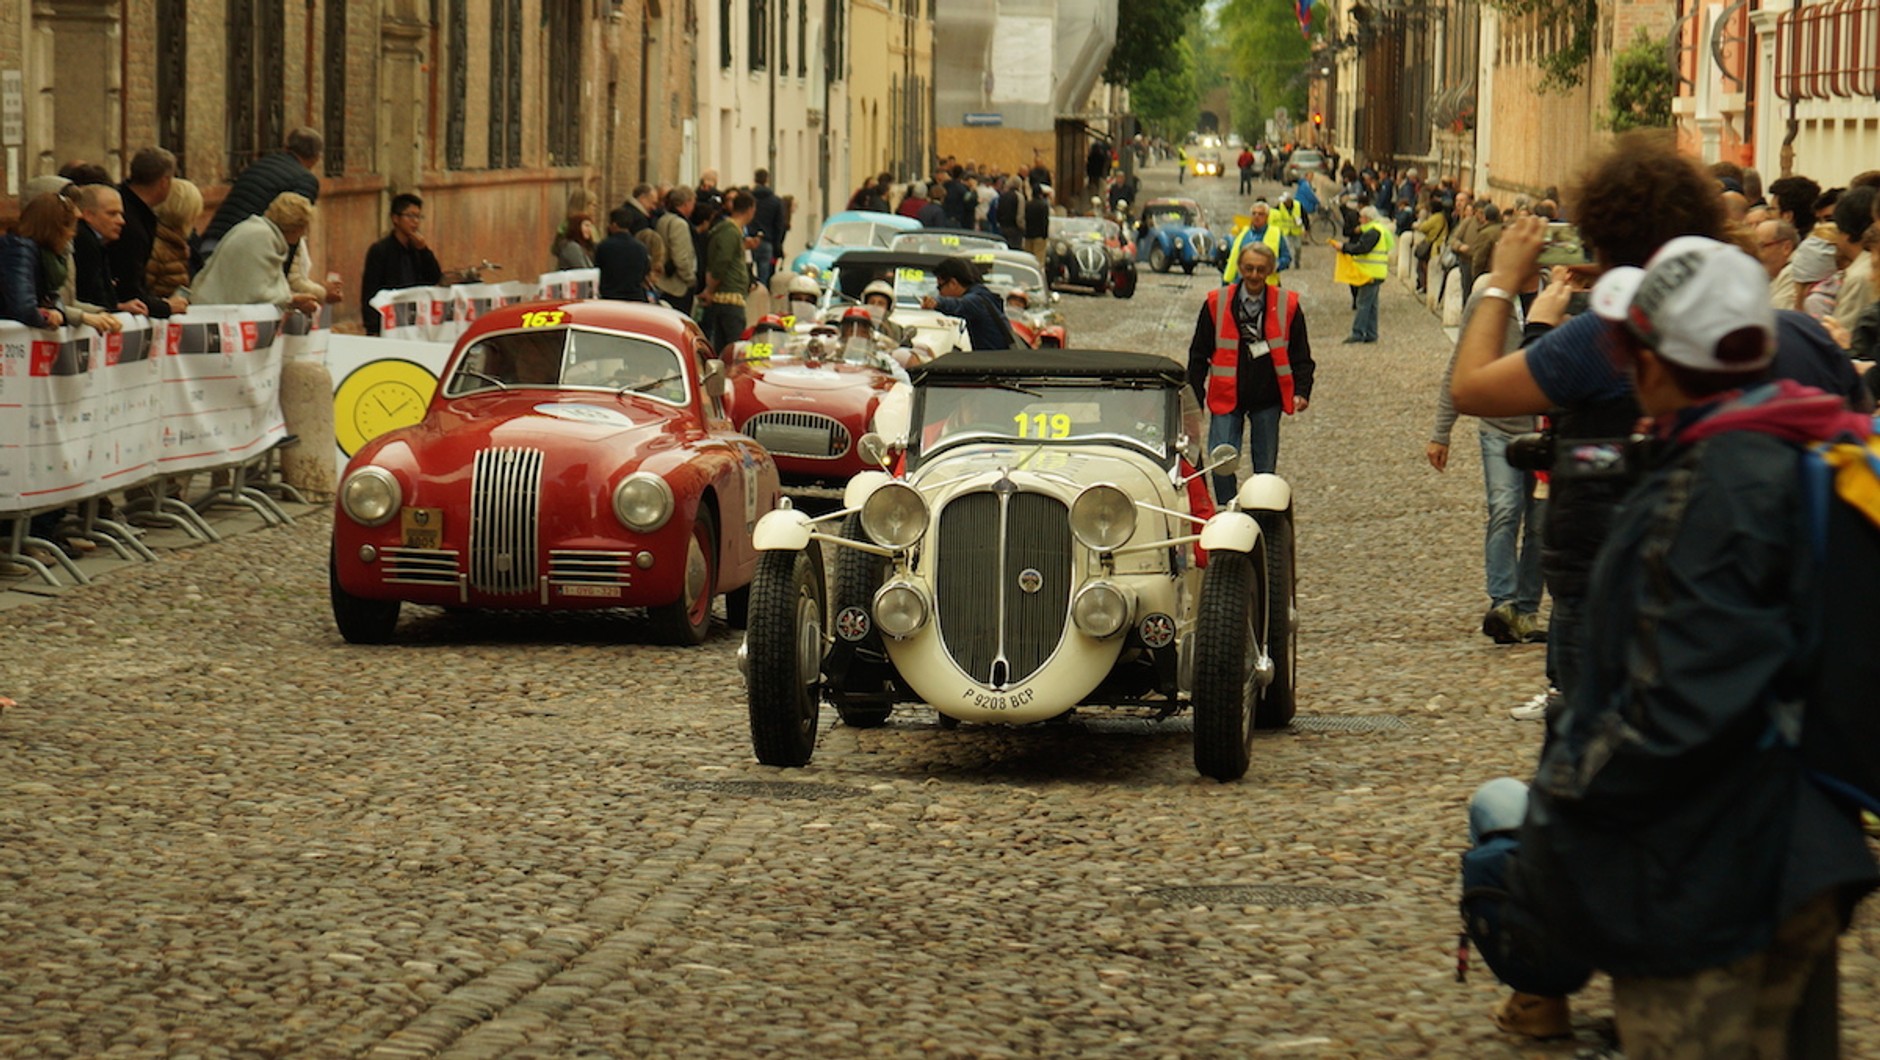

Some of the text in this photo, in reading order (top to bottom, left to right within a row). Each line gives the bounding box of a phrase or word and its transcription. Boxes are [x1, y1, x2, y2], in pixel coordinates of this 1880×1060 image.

[899, 268, 925, 282] 168
[521, 311, 565, 329] 163
[744, 343, 774, 359] 165
[1013, 411, 1071, 439] 119
[963, 688, 1034, 710] P 9208 BCP
